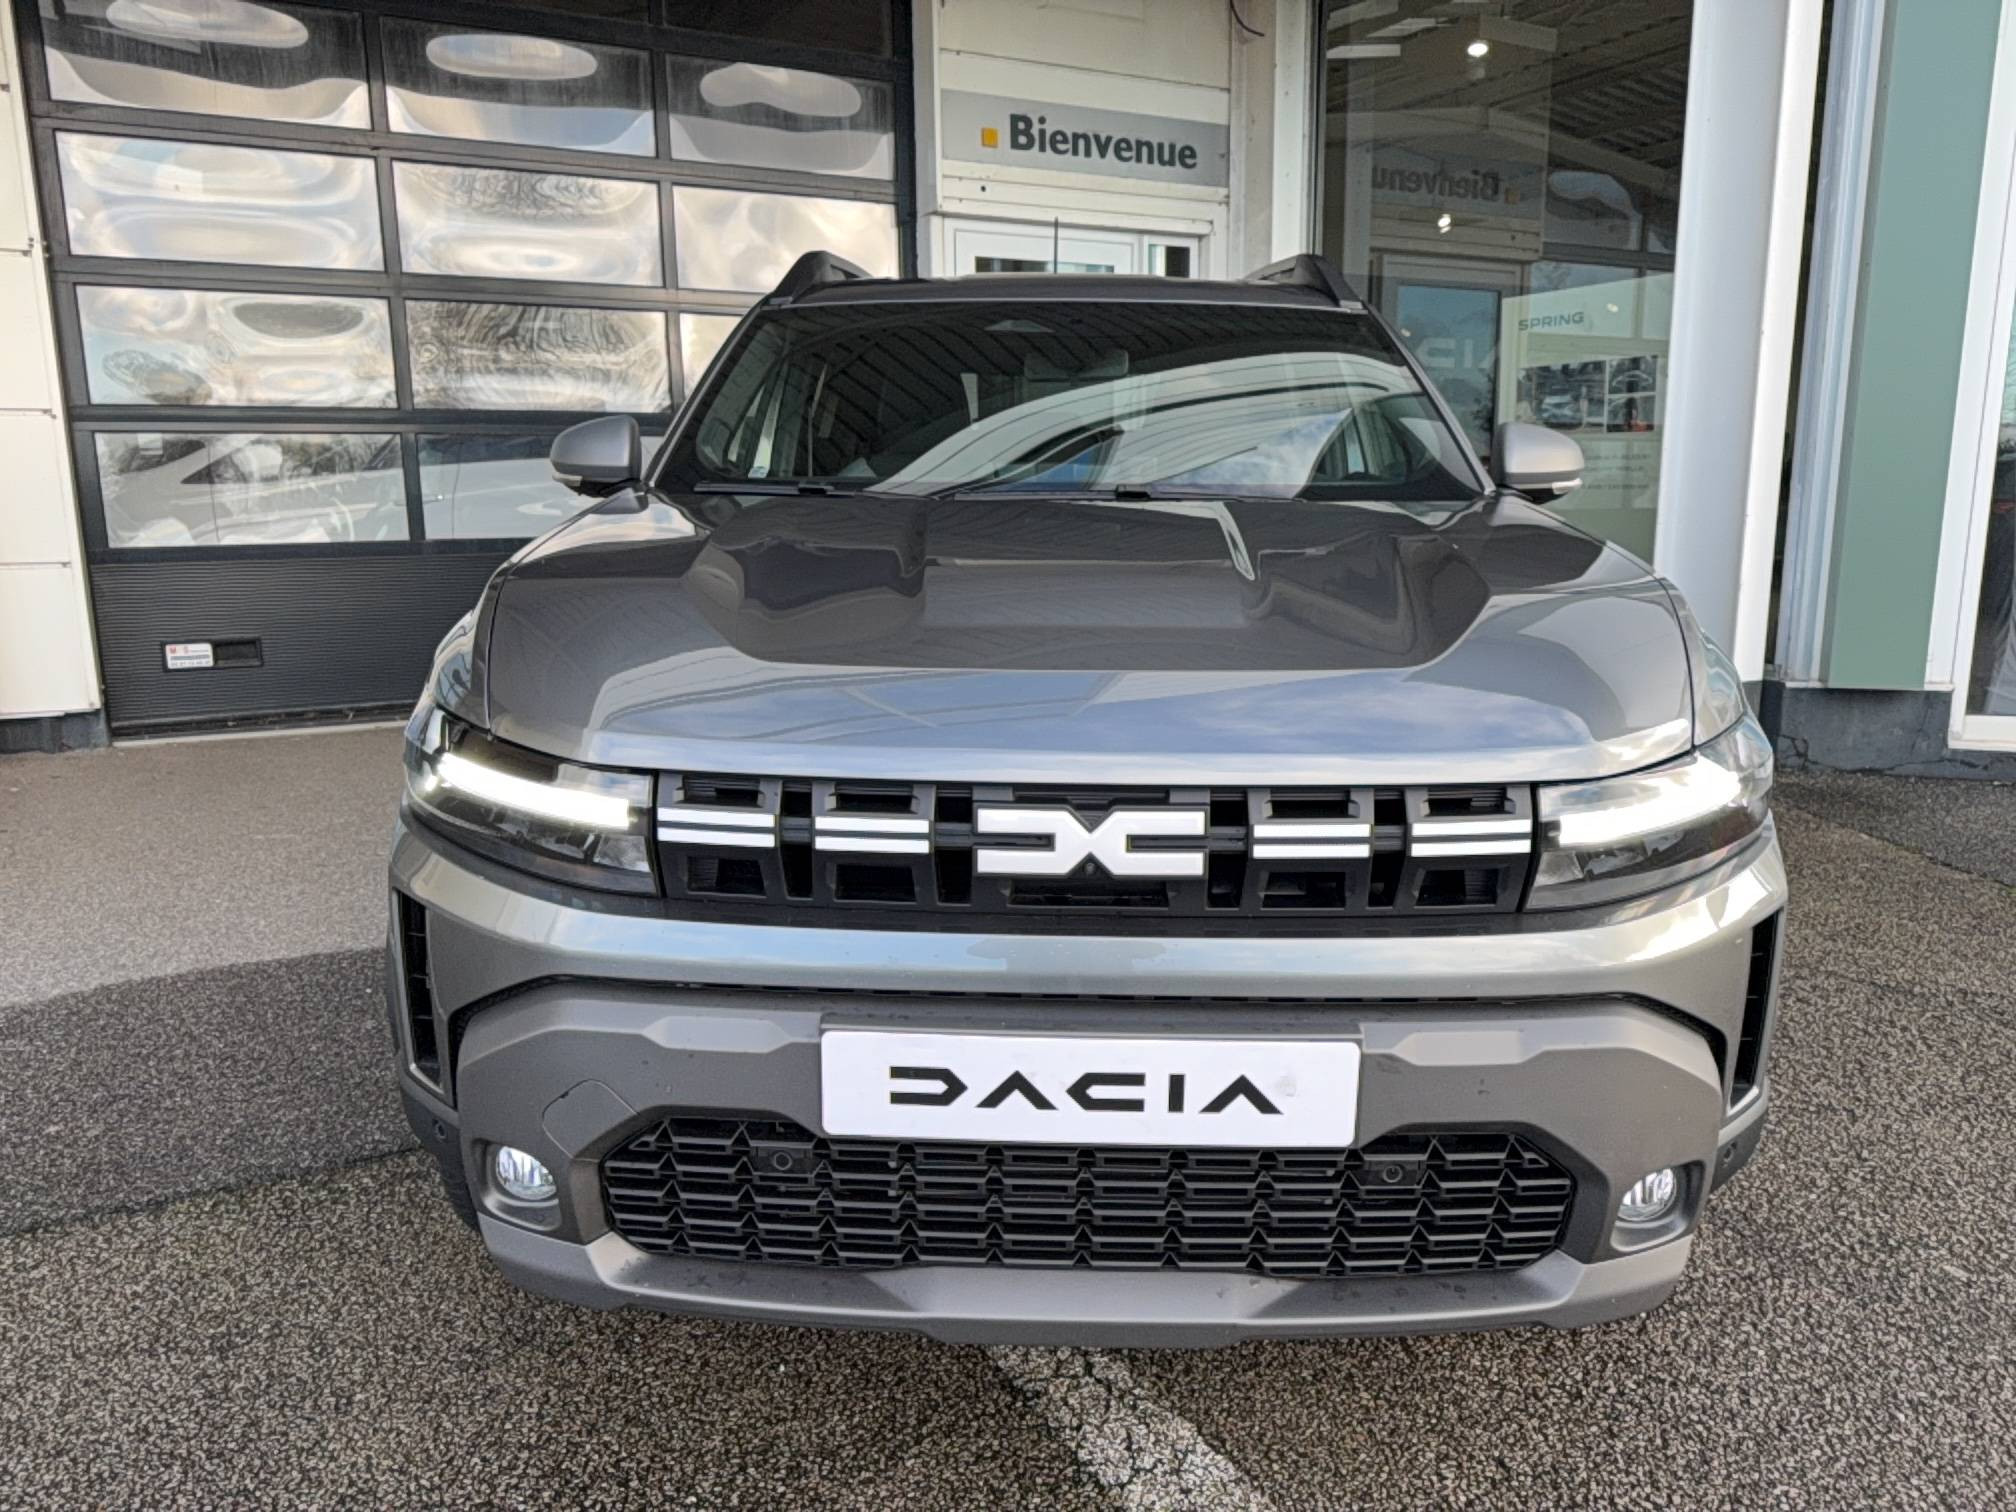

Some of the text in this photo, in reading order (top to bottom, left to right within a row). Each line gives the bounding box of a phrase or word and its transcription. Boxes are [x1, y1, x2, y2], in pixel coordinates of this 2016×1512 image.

[1009, 113, 1198, 170] Bienvenue
[1517, 310, 1585, 332] SPRING
[889, 1065, 1285, 1116] DACIA
